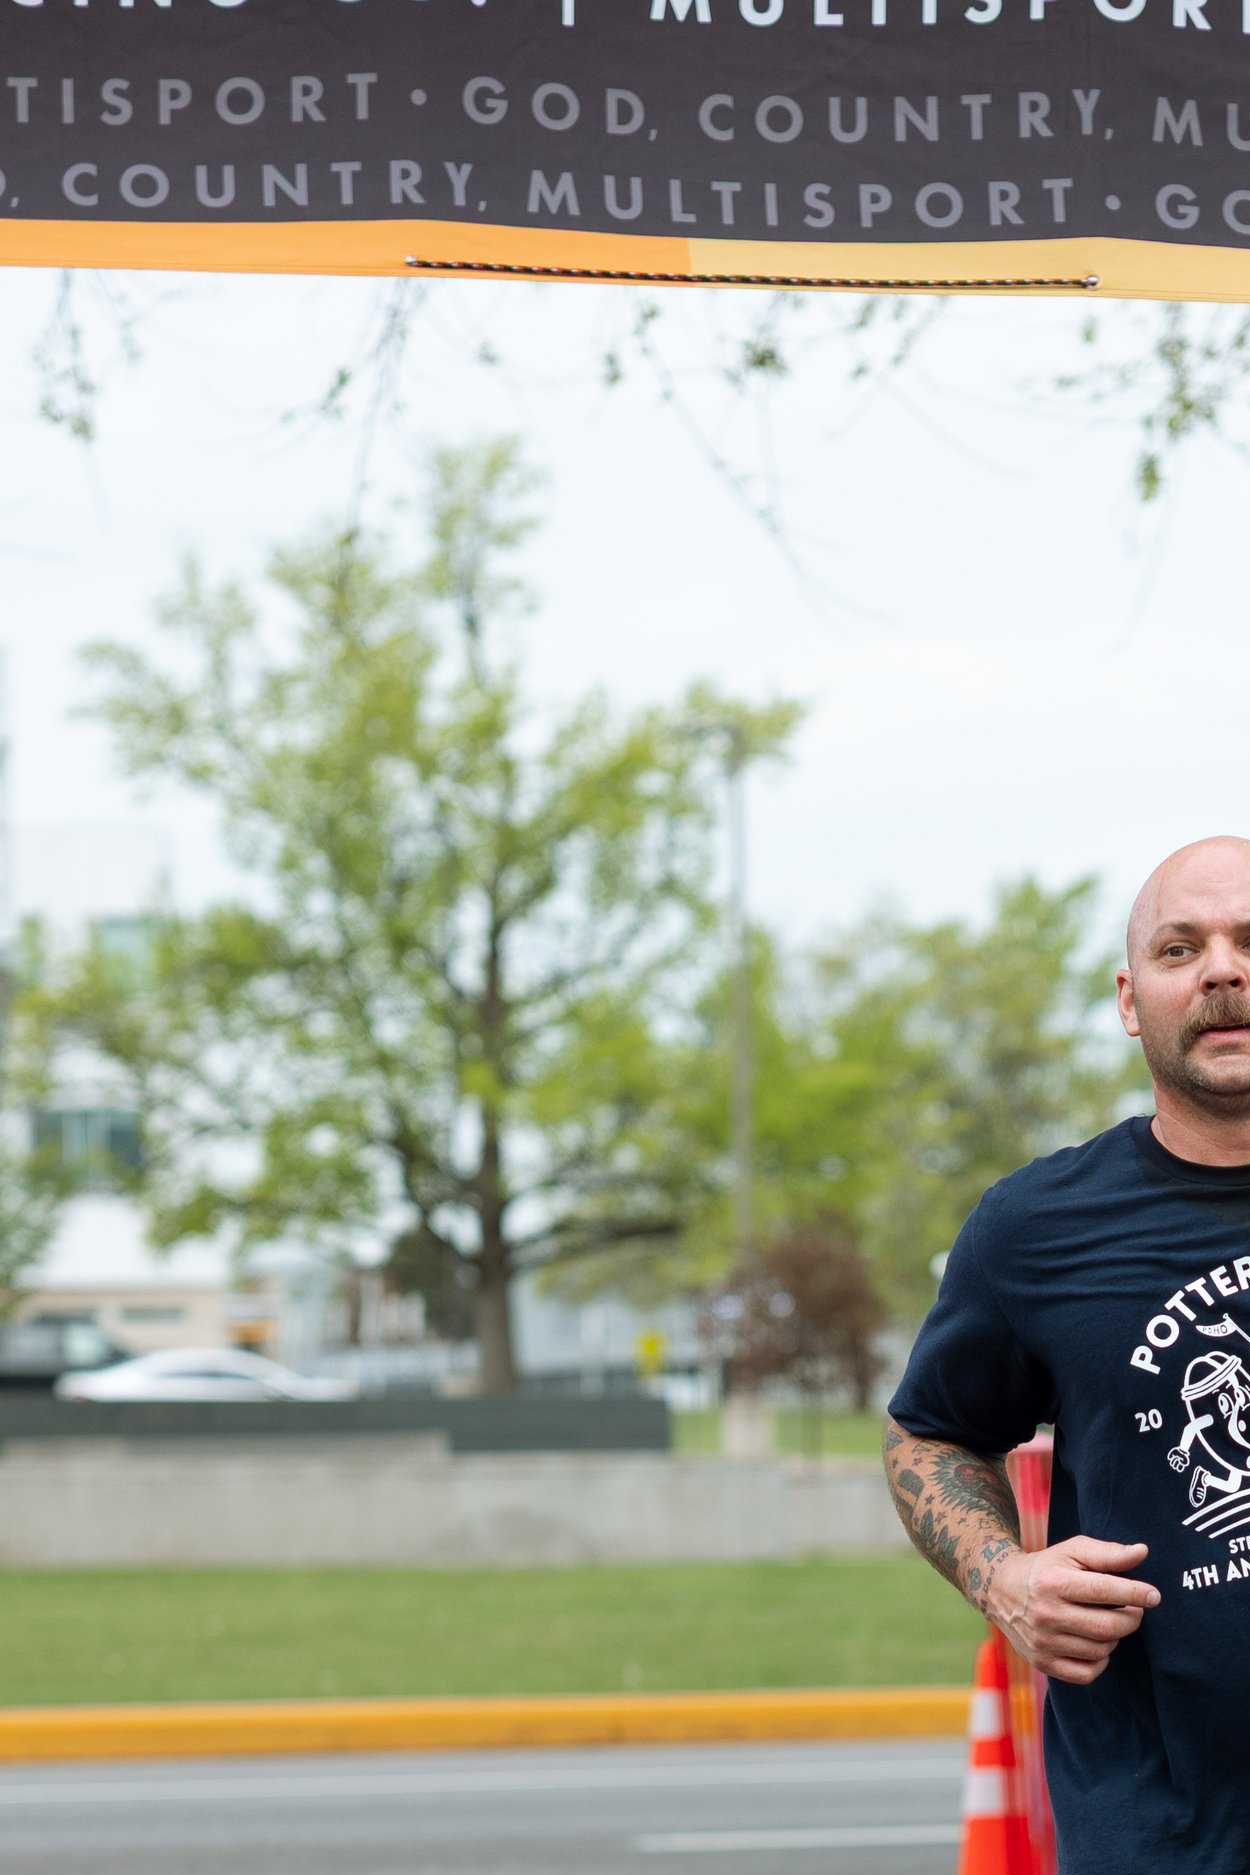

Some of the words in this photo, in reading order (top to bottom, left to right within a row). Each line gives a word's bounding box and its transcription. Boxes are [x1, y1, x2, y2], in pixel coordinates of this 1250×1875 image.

[6, 72, 378, 126] TISPORT
[462, 76, 658, 141] GOD,
[698, 88, 1114, 144] COUNTRY,
[61, 159, 487, 212] COUNTRY,
[527, 169, 1074, 228] MULTISPORT
[1134, 1408, 1163, 1433] 20
[1182, 1564, 1220, 1591] 4TH
